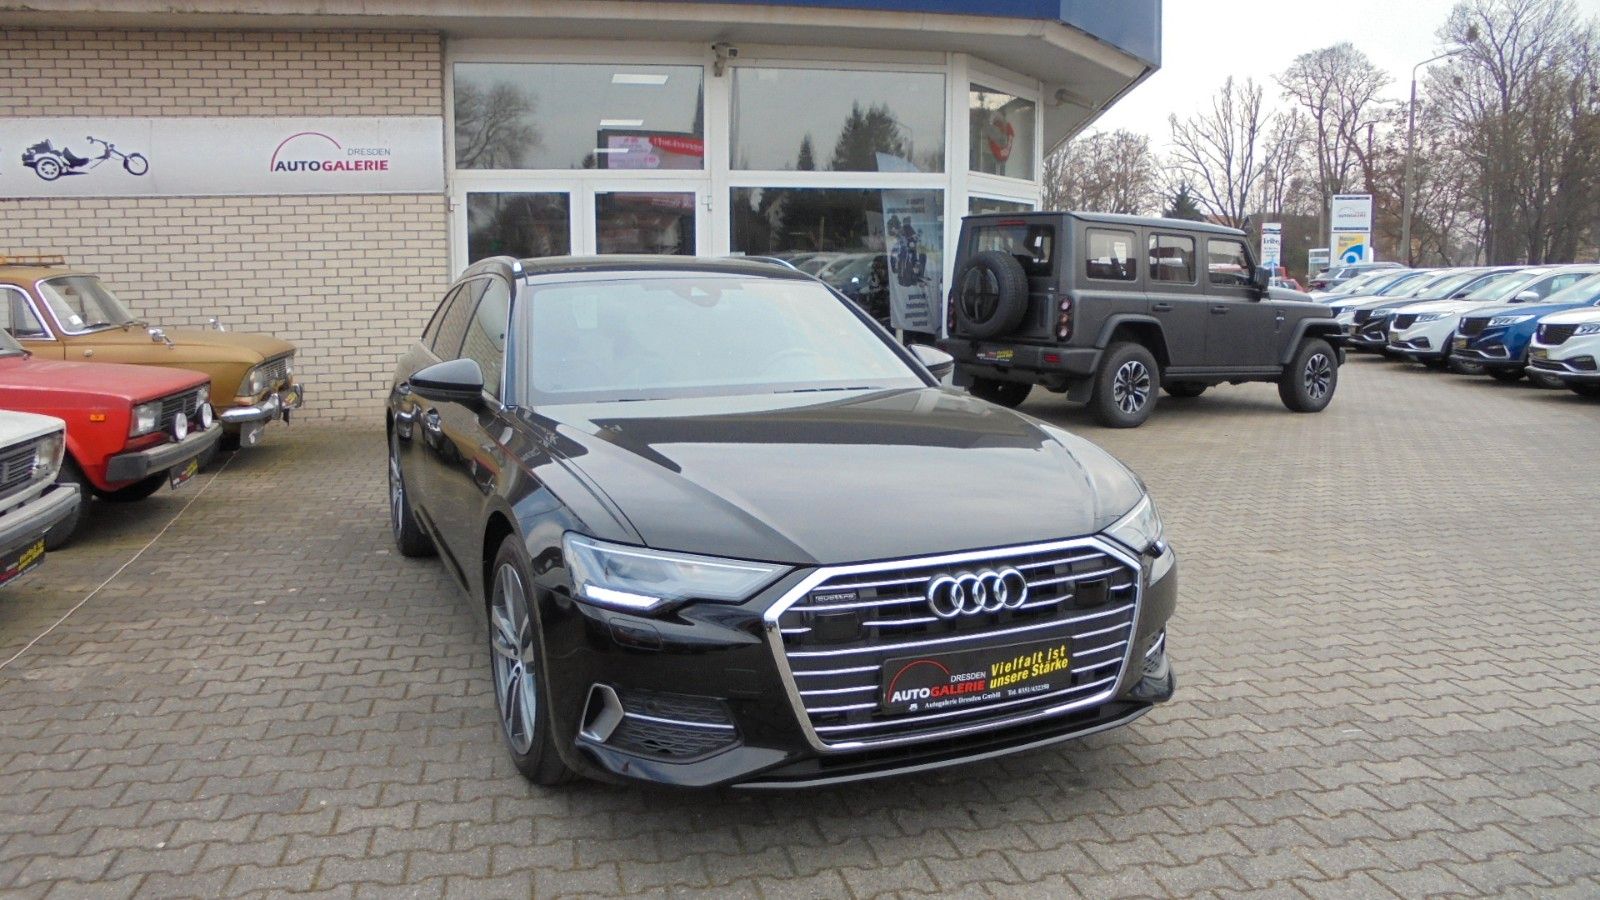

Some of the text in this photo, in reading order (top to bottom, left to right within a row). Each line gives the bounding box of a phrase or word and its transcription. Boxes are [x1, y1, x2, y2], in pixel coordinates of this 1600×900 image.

[347, 147, 391, 156] DRESDEN
[274, 159, 389, 172] AUTOGALERIE
[991, 644, 1066, 677] Vielfalt ist
[950, 671, 987, 683] DRESDEN
[989, 657, 1069, 690] unsere Stärke
[891, 680, 986, 703] AUTOGALERIE
[958, 695, 982, 704] Dresden
